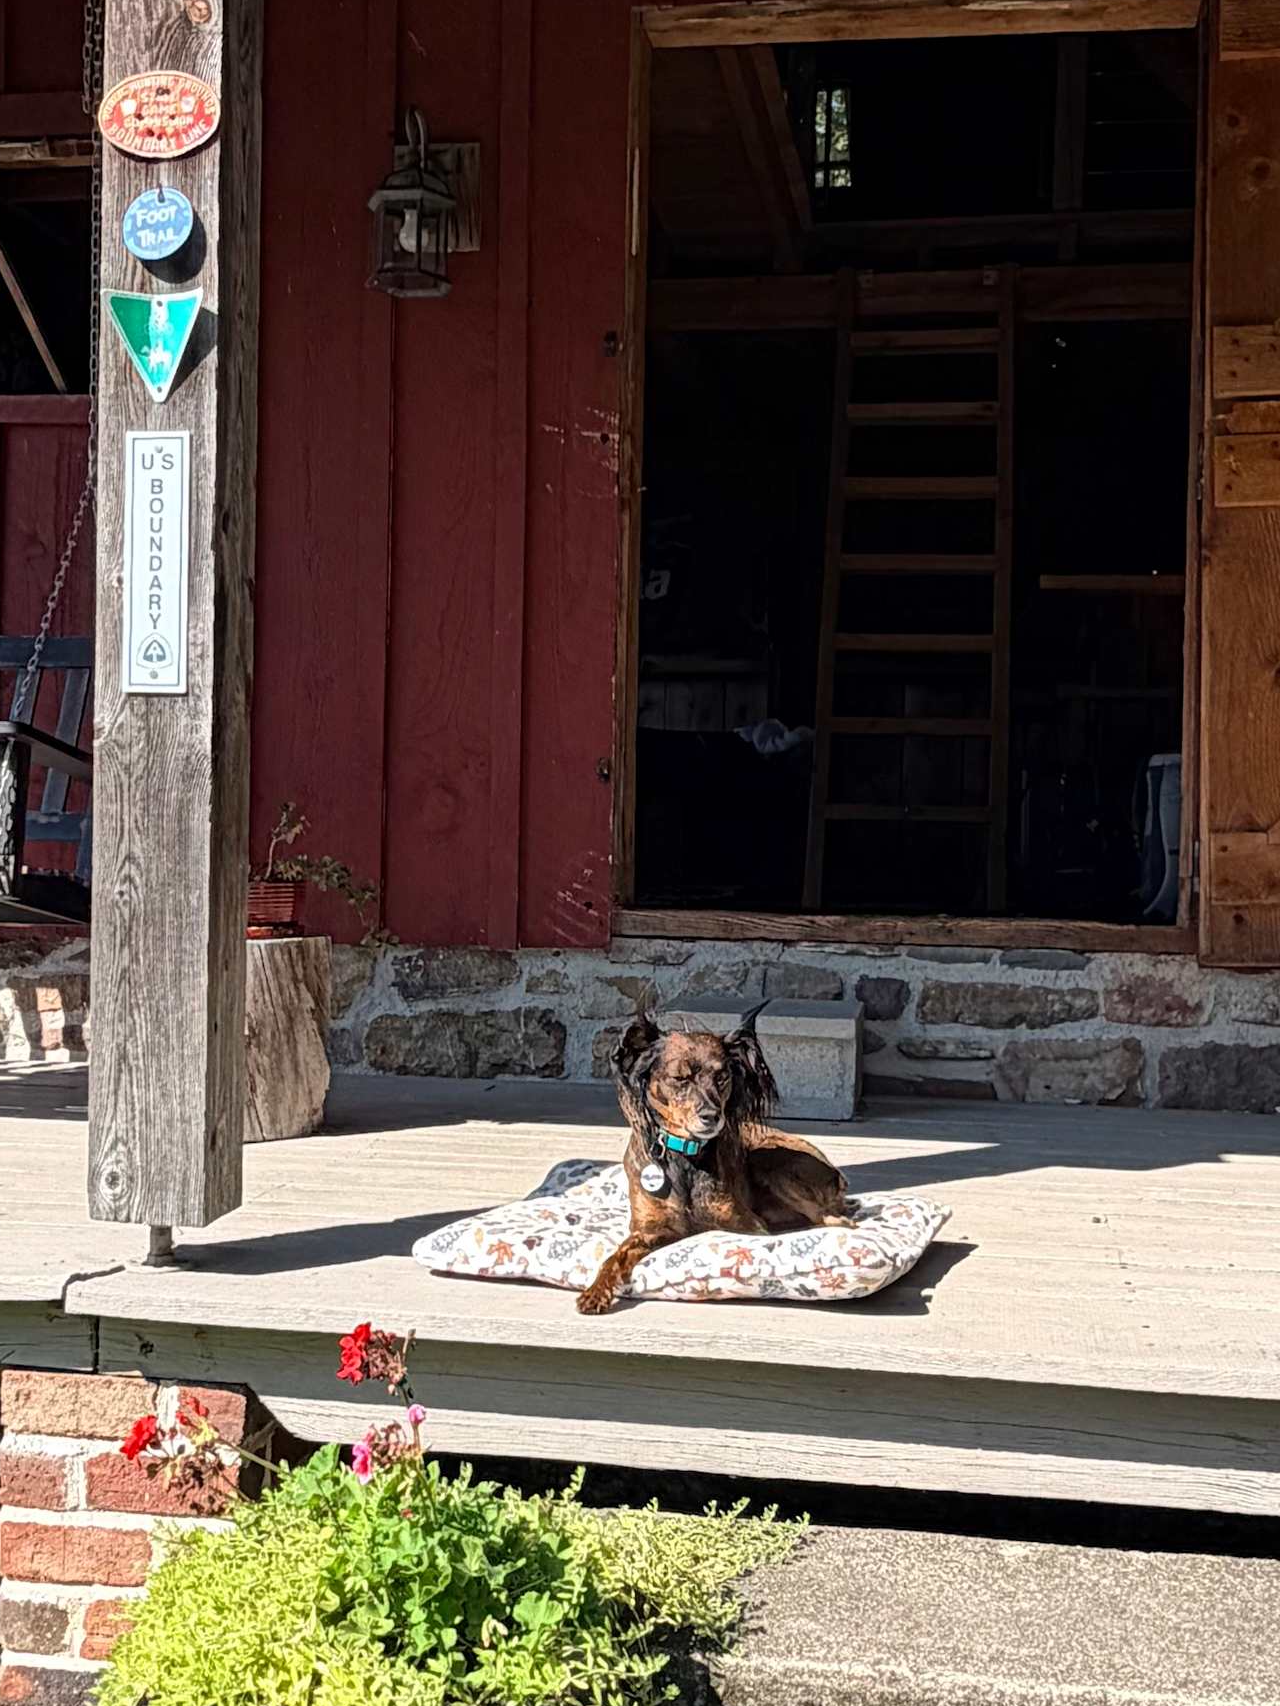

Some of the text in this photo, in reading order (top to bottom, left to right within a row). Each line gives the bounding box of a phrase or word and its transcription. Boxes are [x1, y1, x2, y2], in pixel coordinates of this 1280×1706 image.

[141, 104, 177, 116] GAME
[108, 119, 209, 152] BOUNDARY LINE
[135, 205, 178, 228] FOOT
[136, 227, 178, 248] TRAIL
[148, 478, 164, 630] BOUNDARY
